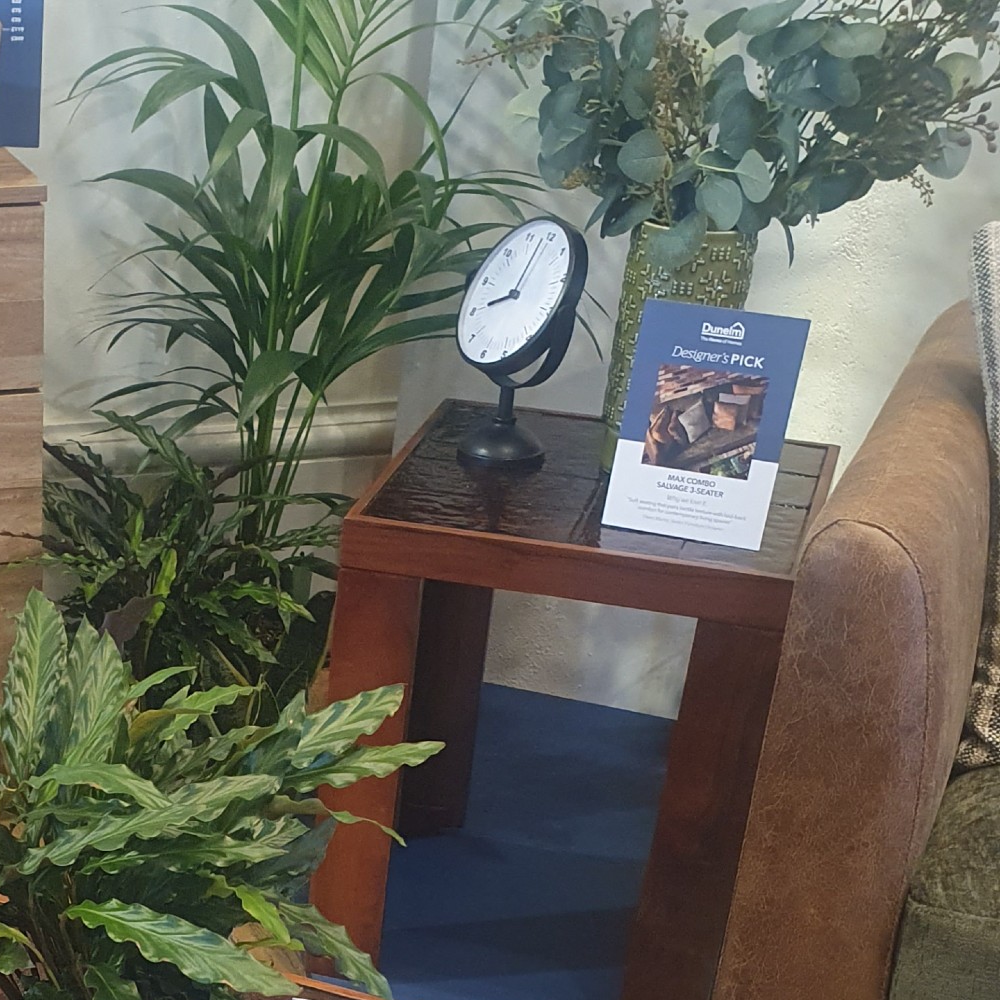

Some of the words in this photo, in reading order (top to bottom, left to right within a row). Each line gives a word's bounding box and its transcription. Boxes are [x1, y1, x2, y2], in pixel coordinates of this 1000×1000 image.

[525, 232, 535, 242] 11
[546, 232, 557, 242] 12
[503, 248, 512, 258] 10
[482, 276, 489, 286] 9
[701, 322, 744, 338] Dunelm
[468, 334, 475, 343] 7
[480, 350, 487, 359] 6
[672, 345, 730, 364] Designer's
[730, 353, 765, 369] PICK
[667, 474, 685, 483] MAX
[686, 477, 716, 488] COMBO
[656, 481, 689, 493] SALVAGE
[689, 486, 724, 498] 3-SEATER
